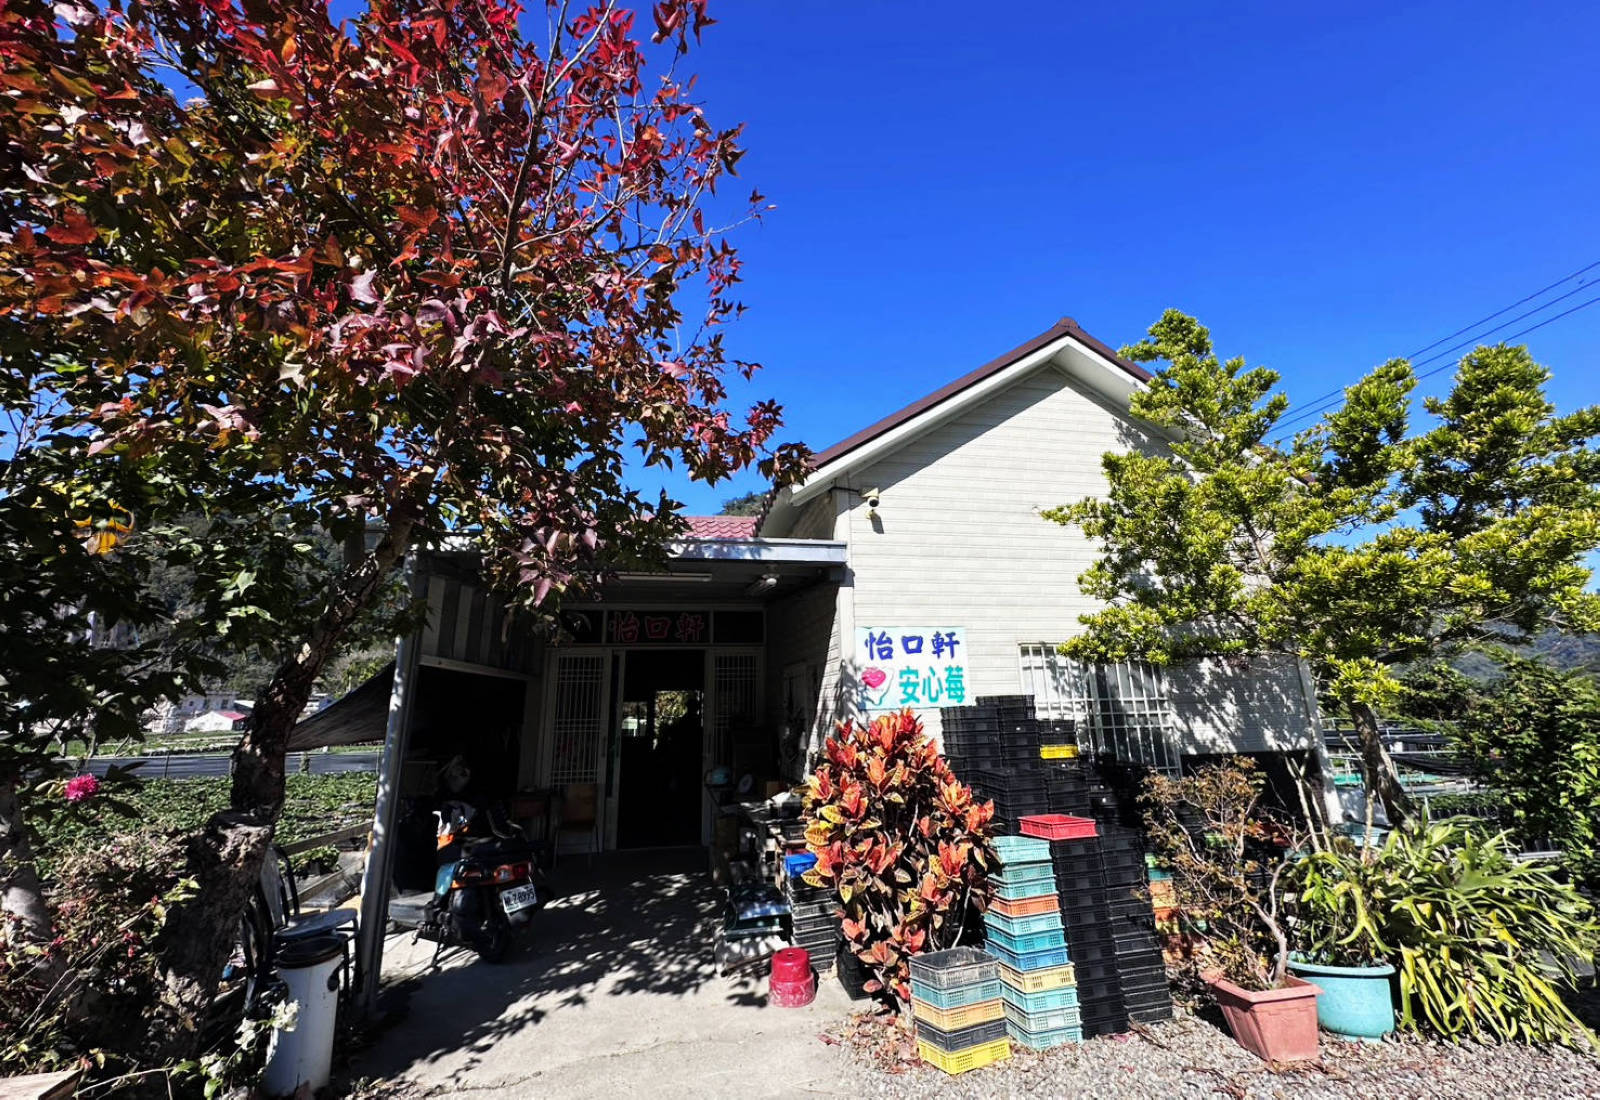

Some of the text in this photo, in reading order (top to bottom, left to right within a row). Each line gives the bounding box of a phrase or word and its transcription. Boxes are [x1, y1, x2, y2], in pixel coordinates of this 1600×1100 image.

[865, 630, 960, 660] 怡口軒
[898, 664, 965, 704] 安心莓
